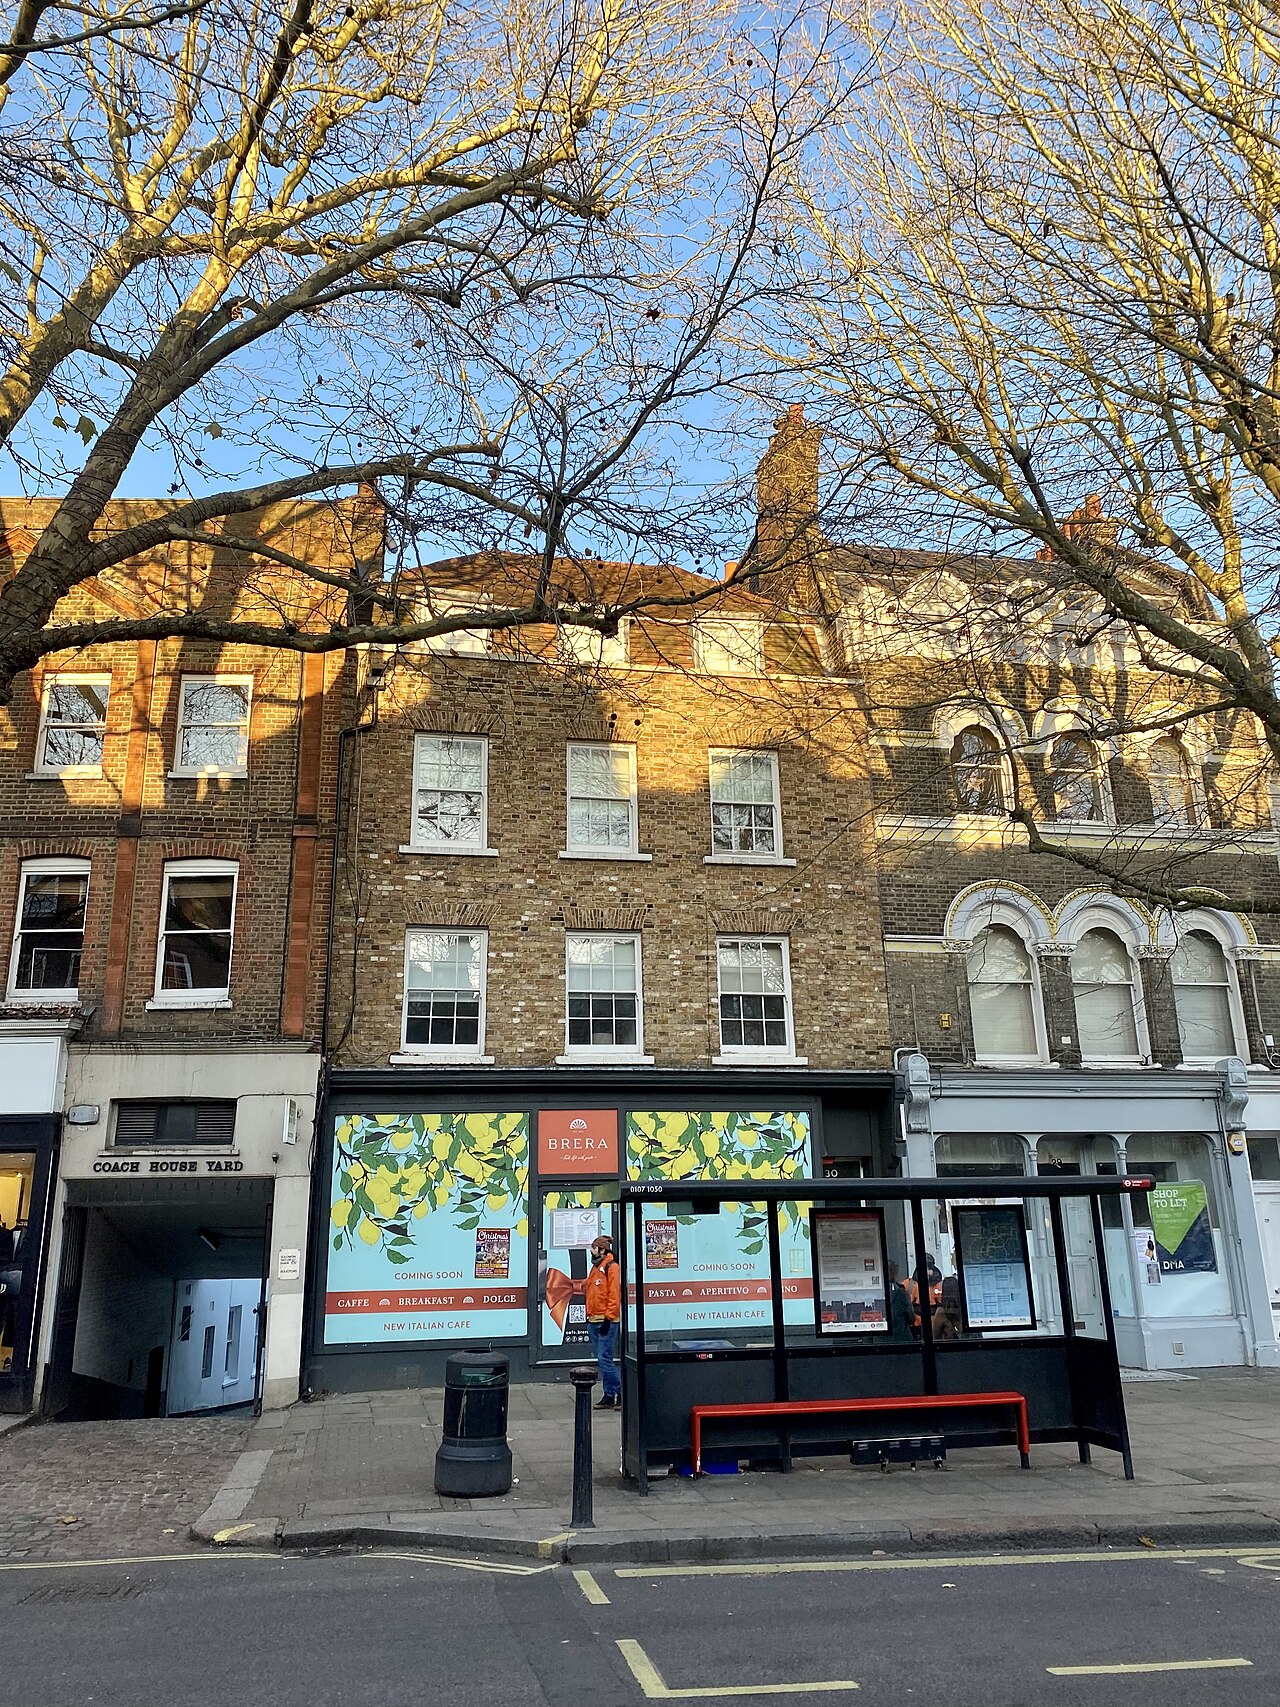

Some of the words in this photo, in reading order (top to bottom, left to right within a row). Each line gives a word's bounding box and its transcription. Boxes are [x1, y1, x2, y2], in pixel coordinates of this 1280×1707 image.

[548, 1137, 609, 1150] BRERA
[93, 1161, 140, 1173] COACH
[149, 1161, 198, 1172] HOUSE
[206, 1160, 244, 1172] YARD
[1051, 1158, 1063, 1169] 29
[825, 1169, 838, 1178] 30
[630, 1185, 646, 1193] 0107
[646, 1185, 663, 1193] 1050
[1153, 1189, 1179, 1199] SHOP
[1153, 1199, 1168, 1208] TO
[1170, 1198, 1188, 1207] LET
[646, 1222, 676, 1232] Christmas
[478, 1231, 509, 1241] Christmas
[692, 1264, 728, 1272] COMING
[730, 1263, 756, 1271] SOON
[1163, 1260, 1185, 1270] DMA
[394, 1272, 433, 1280] COMING
[436, 1271, 463, 1279] SOON
[648, 1289, 677, 1298] PASTA
[699, 1286, 749, 1296] APERITIVO
[782, 1285, 798, 1293] INO
[338, 1299, 370, 1308] CAFFE
[398, 1296, 455, 1306] BREAKFAST
[482, 1294, 517, 1304] DOLCE
[686, 1312, 707, 1320] NEW
[708, 1311, 742, 1320] ITALIAN
[744, 1310, 766, 1318] CAFE
[383, 1322, 406, 1331] NEW
[408, 1321, 444, 1330] ITALIAN
[447, 1320, 471, 1329] CAFE
